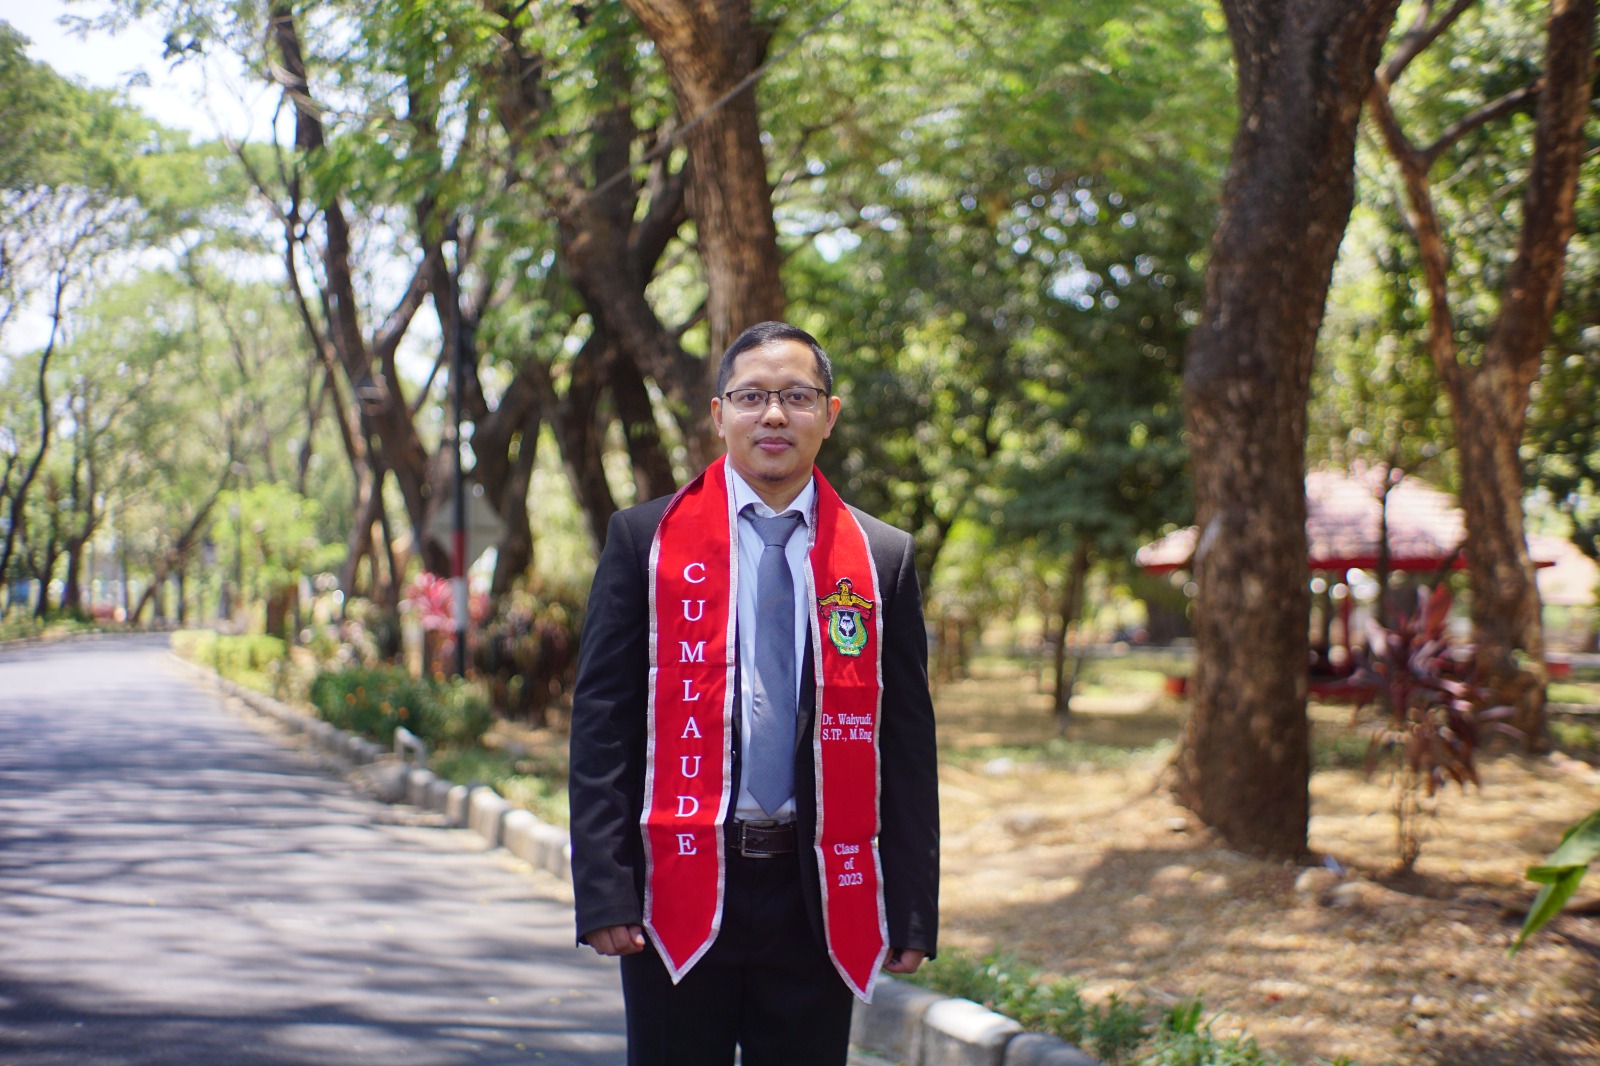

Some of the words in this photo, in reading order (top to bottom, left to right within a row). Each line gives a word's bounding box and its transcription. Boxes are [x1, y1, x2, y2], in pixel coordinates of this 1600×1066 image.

[822, 713, 835, 725] Dr.
[838, 713, 873, 728] Wahyudi,
[822, 728, 847, 742] S.TP.,
[833, 843, 860, 855] Class
[844, 857, 855, 870] of
[838, 872, 863, 887] 2023
